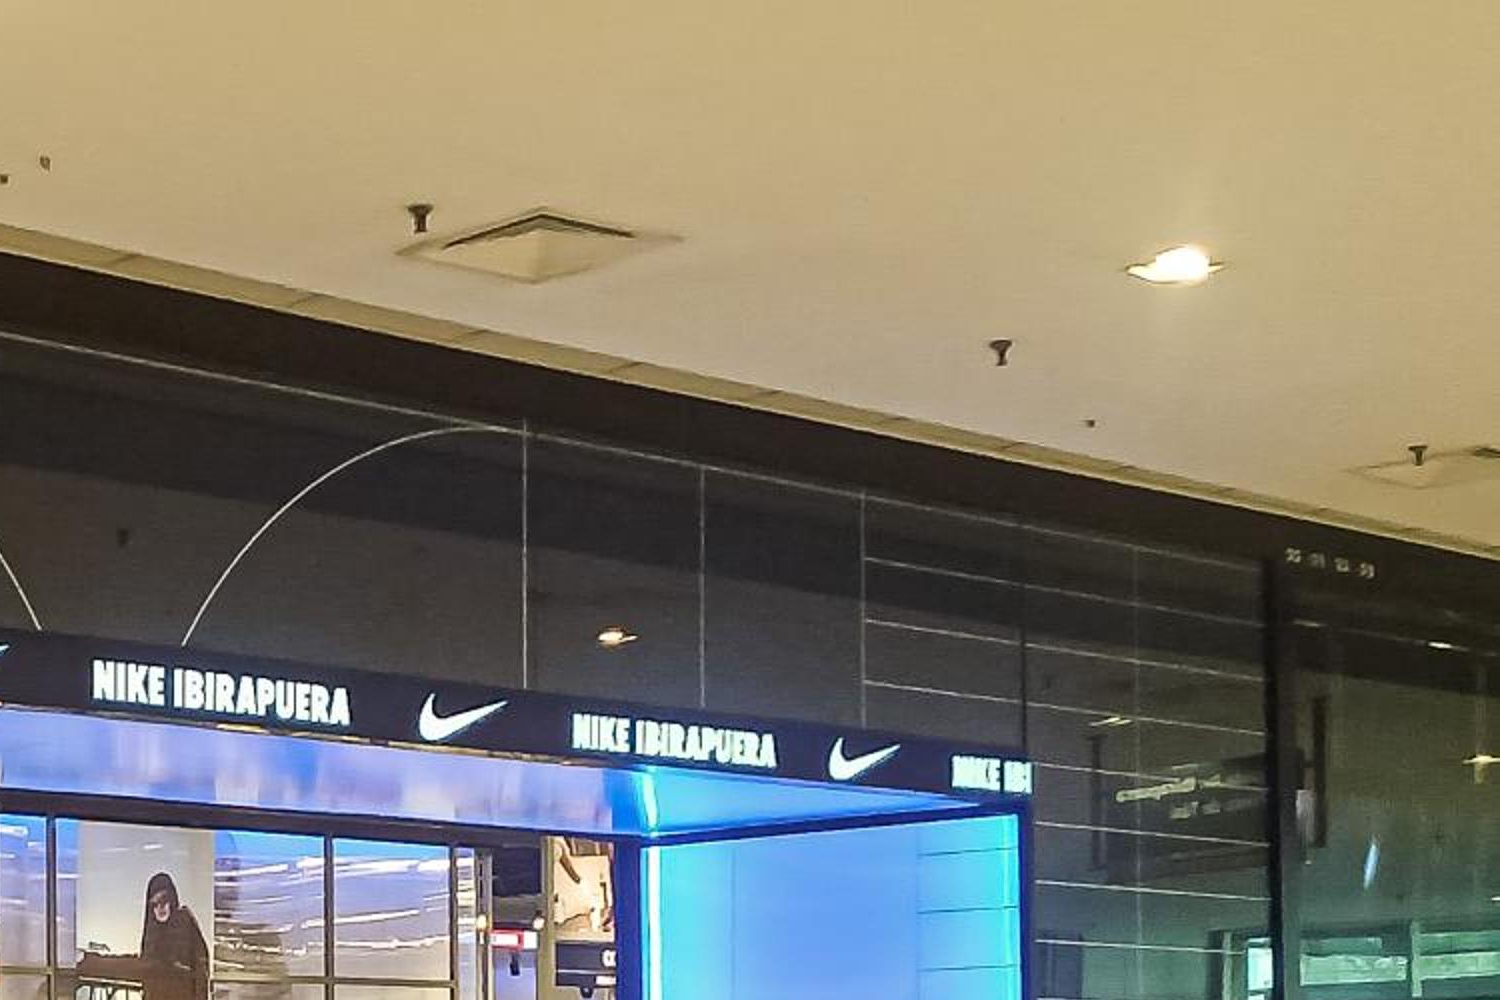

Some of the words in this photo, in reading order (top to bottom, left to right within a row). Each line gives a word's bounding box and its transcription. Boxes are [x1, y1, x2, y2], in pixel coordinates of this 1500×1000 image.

[92, 660, 165, 706] NIKE
[173, 667, 350, 727] IBIRAPUERA
[571, 713, 630, 754] NIKE
[635, 720, 777, 768] IBIRAPUERA
[952, 755, 1001, 791] NIKE
